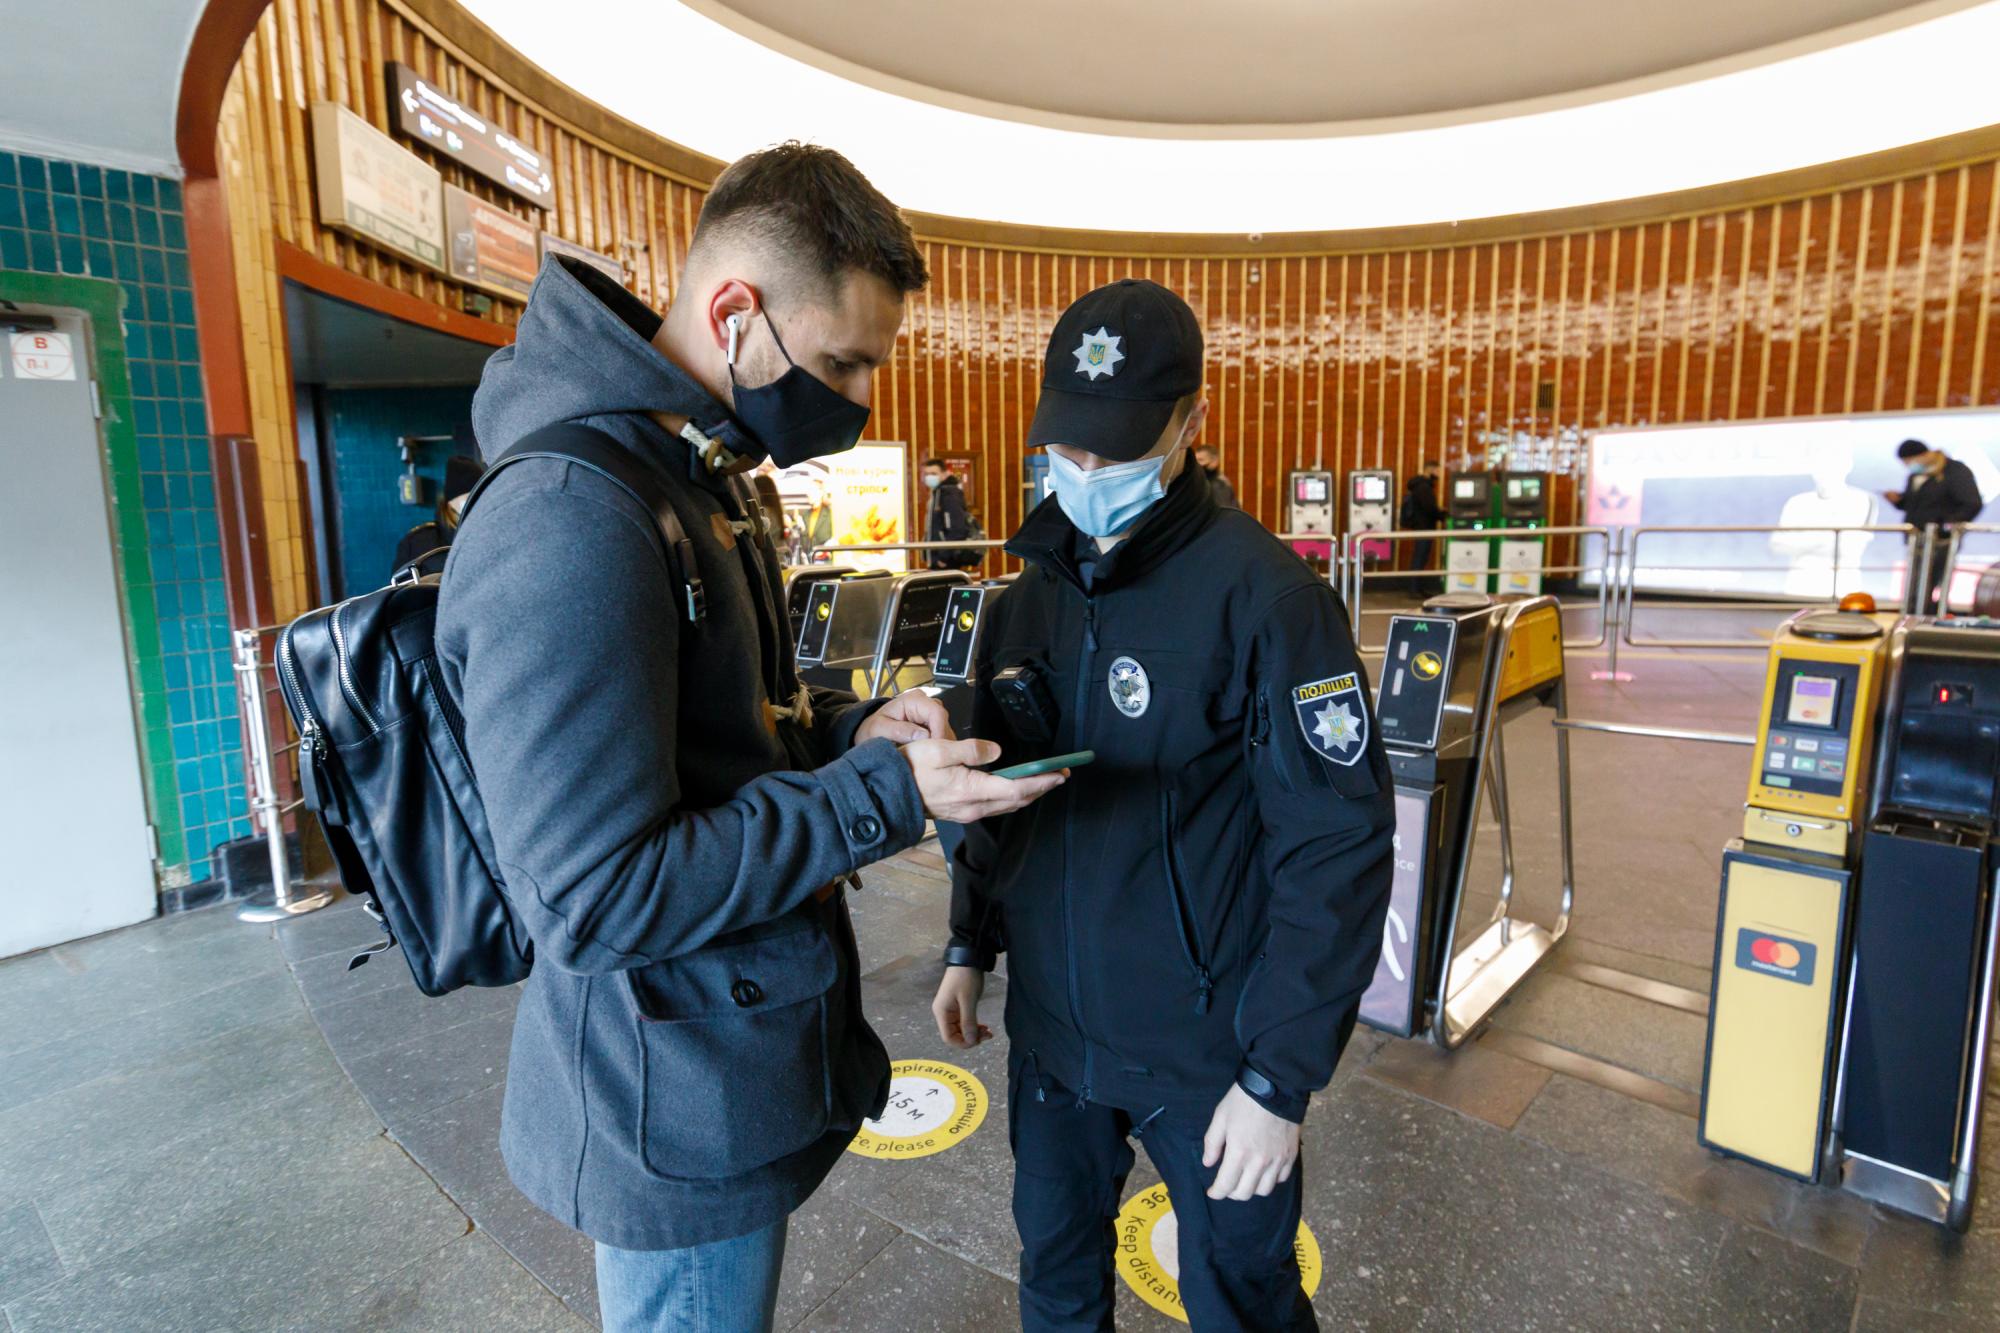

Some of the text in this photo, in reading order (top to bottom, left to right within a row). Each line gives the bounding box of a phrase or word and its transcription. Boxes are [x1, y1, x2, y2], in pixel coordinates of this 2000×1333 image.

[1299, 677, 1354, 700] ПОЛІЦІЯ
[892, 1063, 958, 1080] ерігайте
[874, 1138, 936, 1153] please
[1119, 1216, 1147, 1253] Keep
[1129, 1257, 1183, 1307] distan
